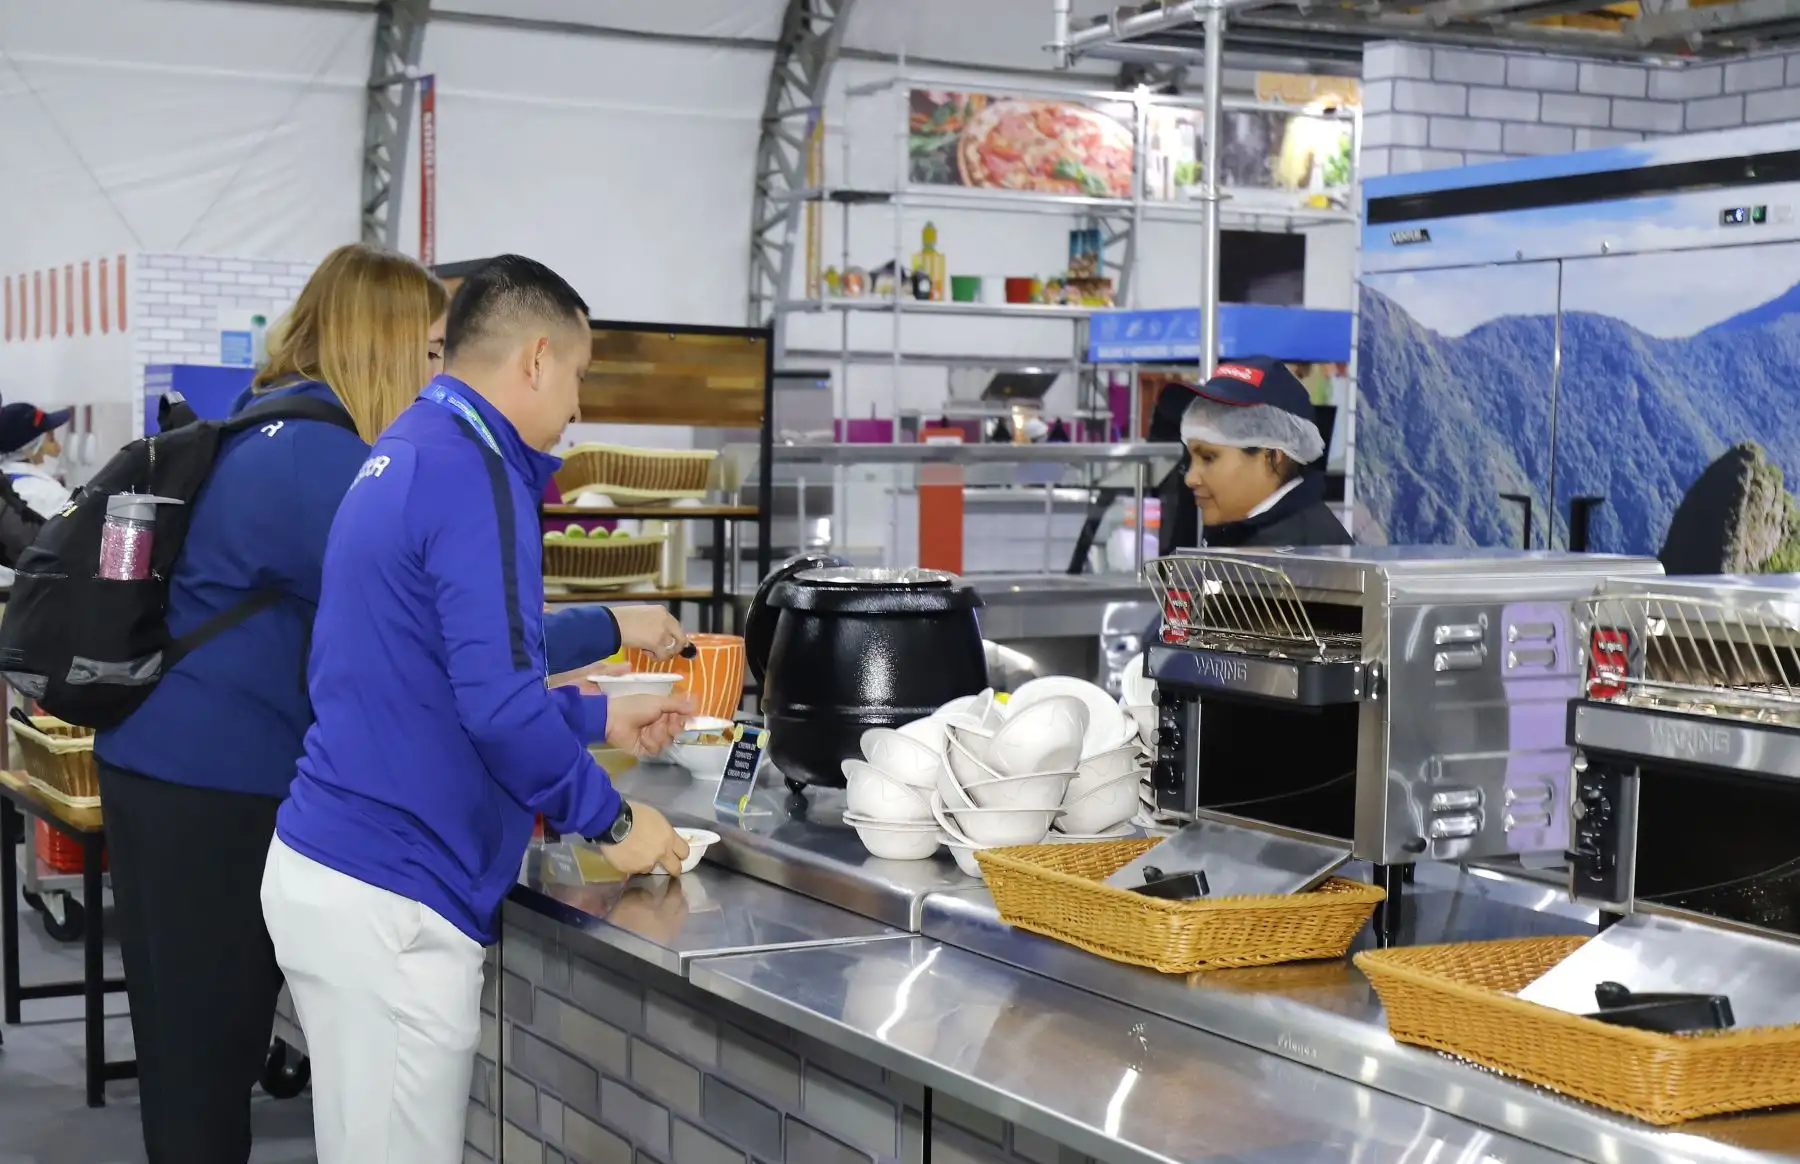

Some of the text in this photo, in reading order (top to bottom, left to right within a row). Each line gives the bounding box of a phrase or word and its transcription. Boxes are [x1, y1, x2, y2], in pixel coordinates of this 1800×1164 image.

[1195, 655, 1247, 685] WARING
[728, 769, 750, 779] CREAM SOUP
